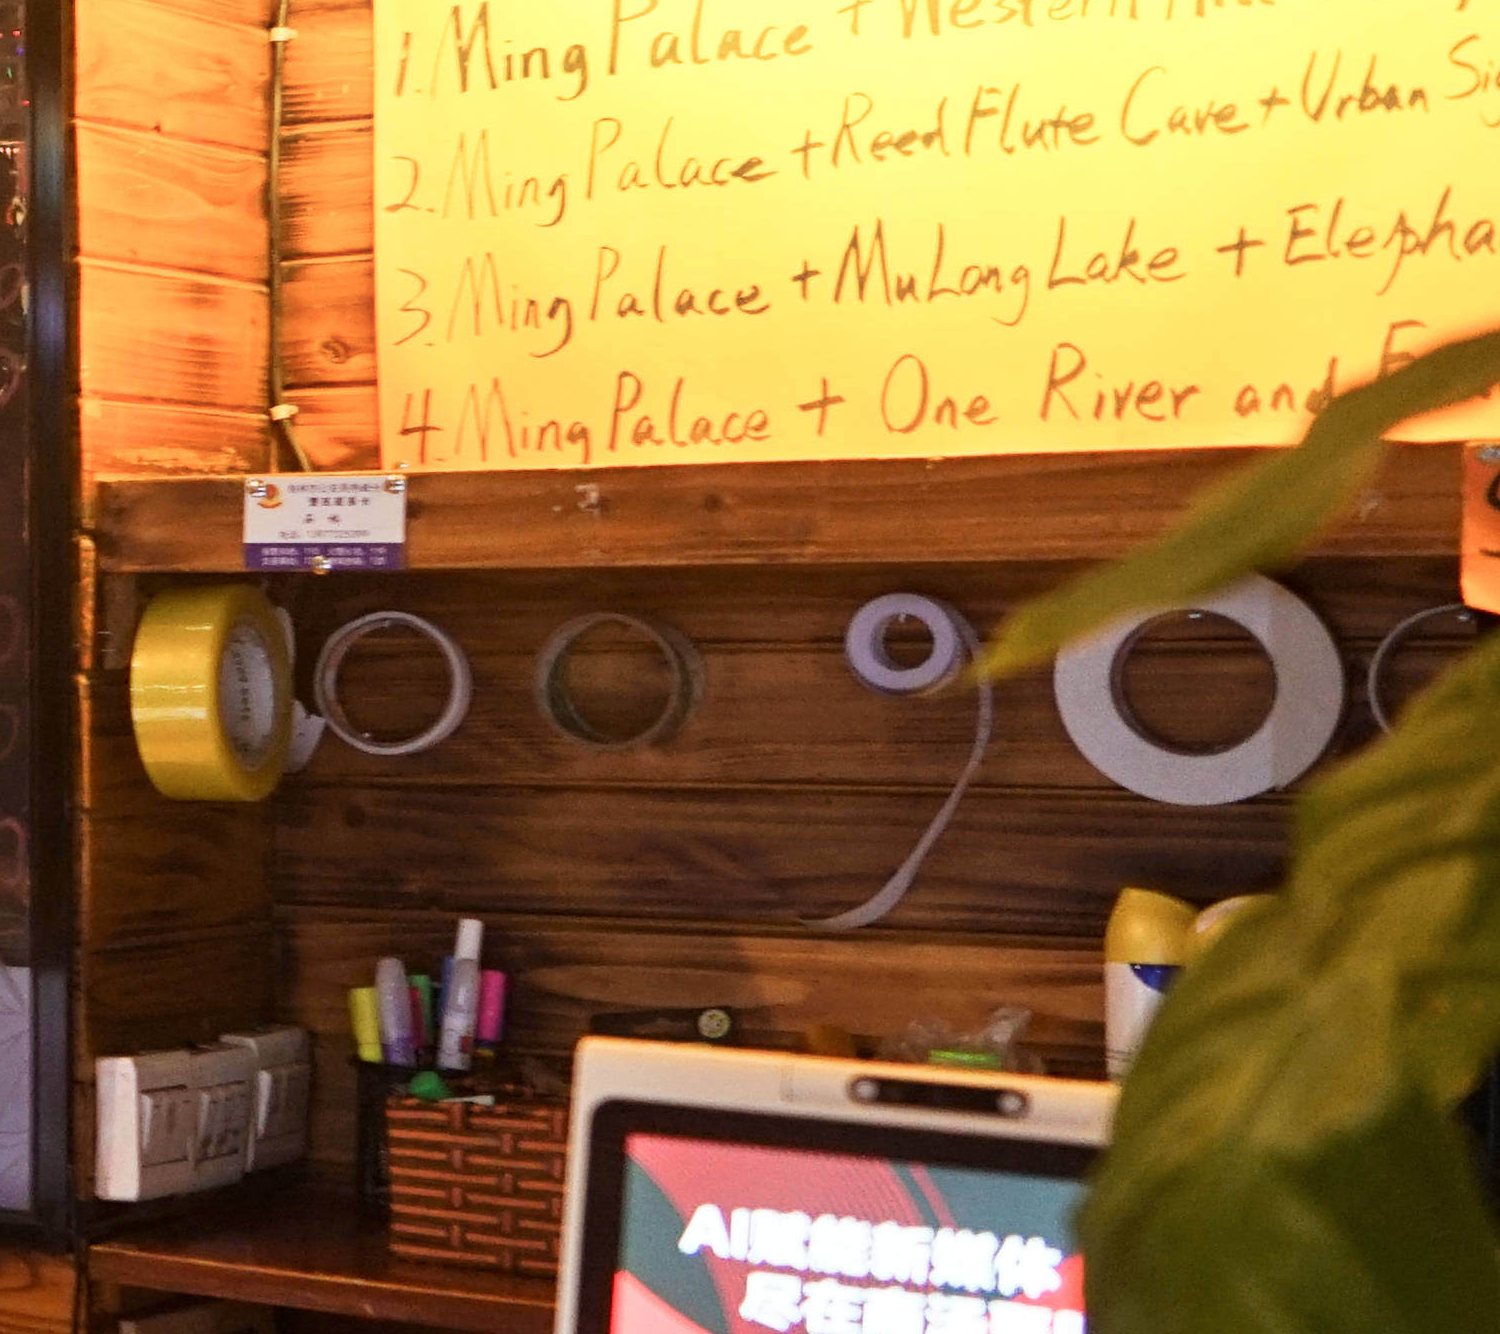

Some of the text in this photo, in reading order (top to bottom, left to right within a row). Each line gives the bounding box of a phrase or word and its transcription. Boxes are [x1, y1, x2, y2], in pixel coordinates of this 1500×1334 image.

[586, 116, 776, 201] Palace
[965, 84, 1101, 156] Flute
[589, 246, 770, 323] Palace
[1047, 216, 1188, 290] Lake
[608, 371, 770, 452] Palace
[882, 354, 998, 433] One
[1040, 343, 1201, 421] River
